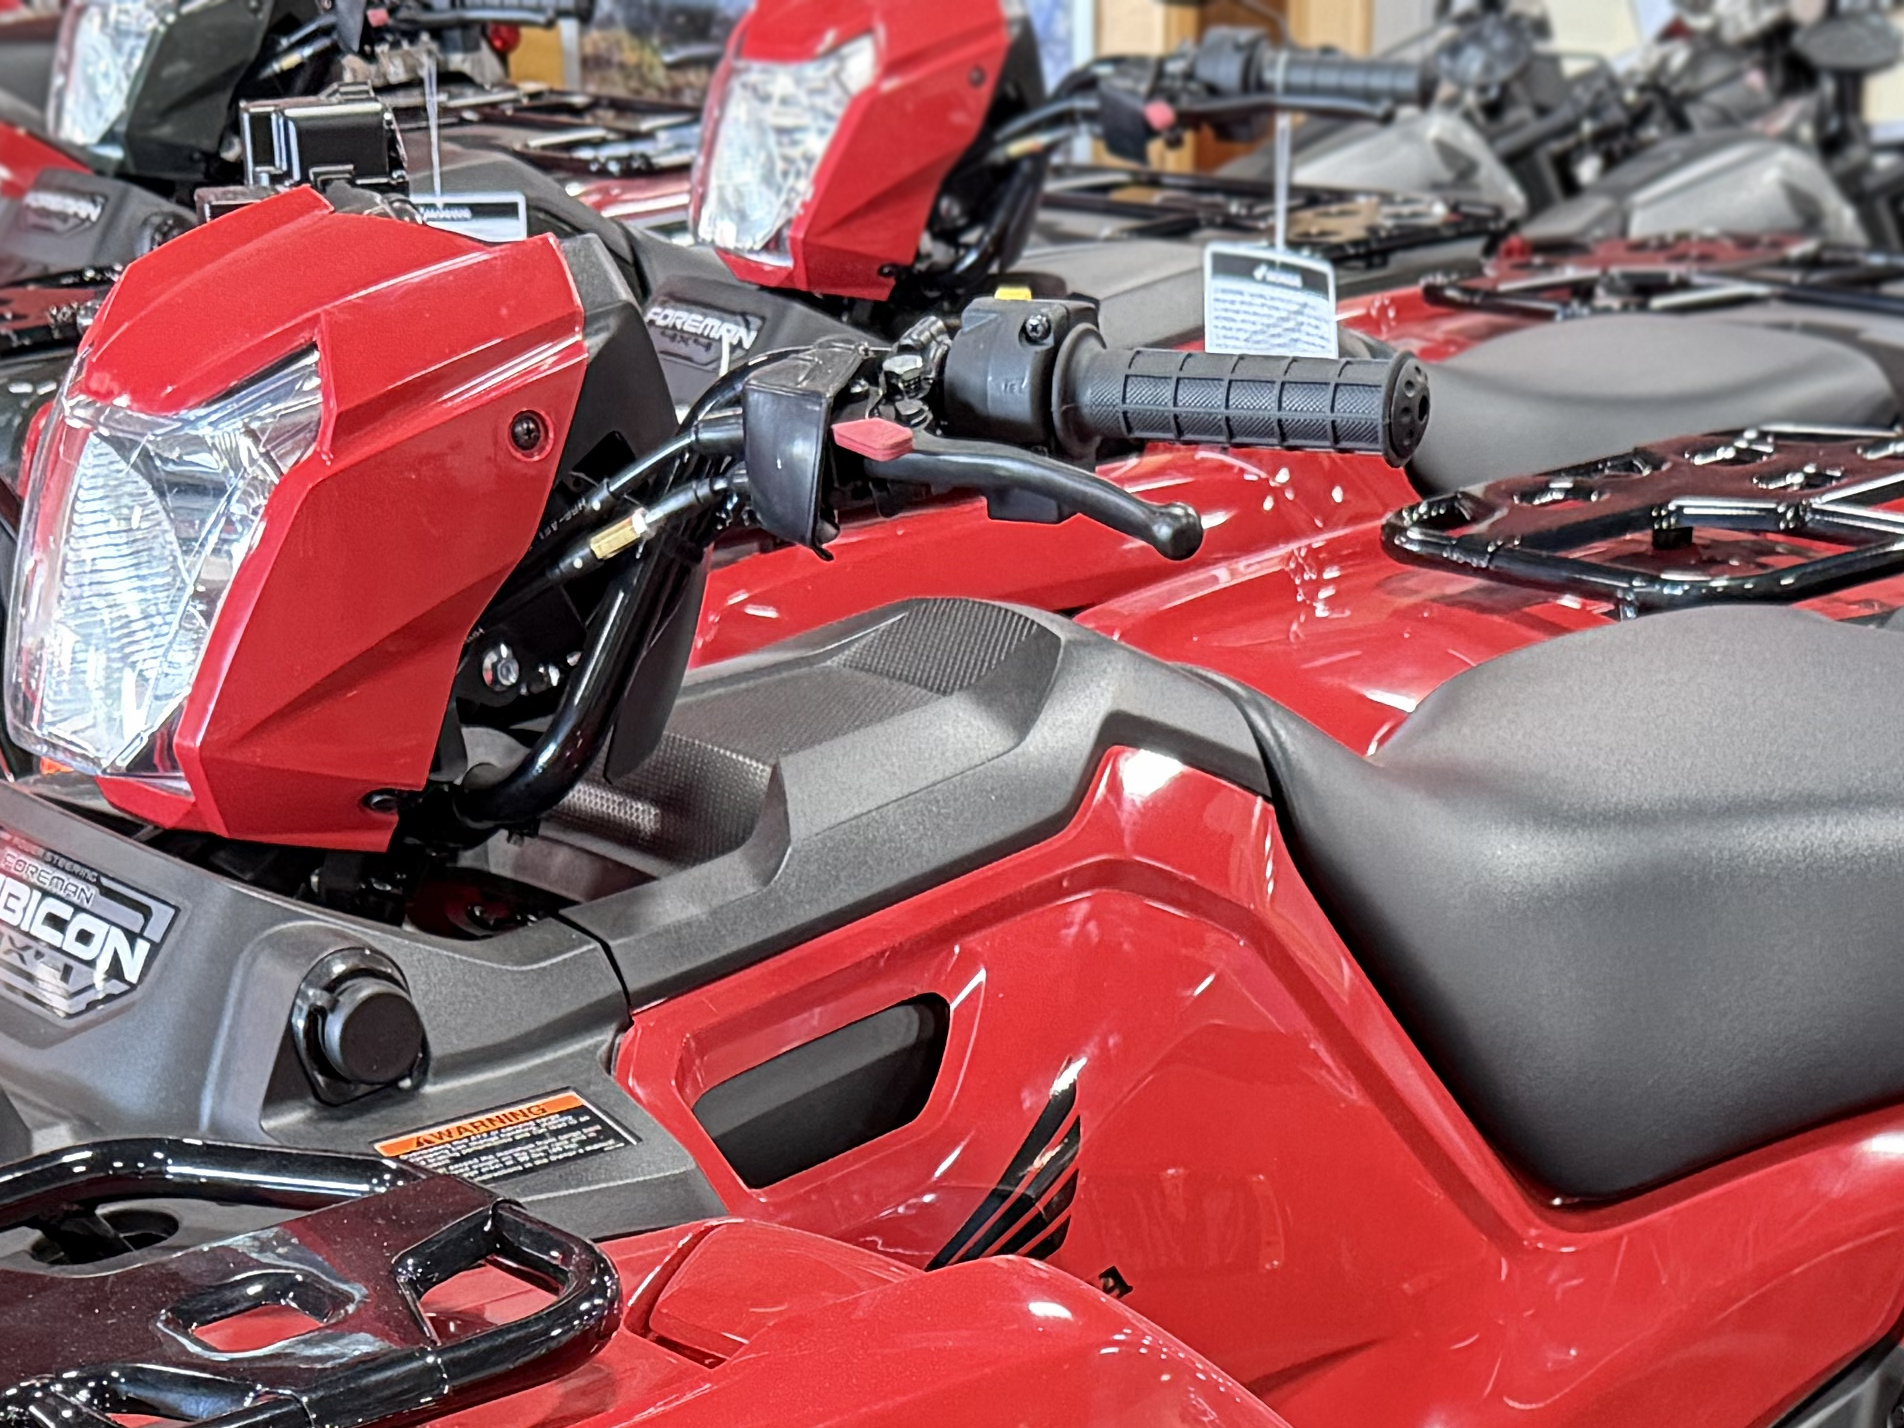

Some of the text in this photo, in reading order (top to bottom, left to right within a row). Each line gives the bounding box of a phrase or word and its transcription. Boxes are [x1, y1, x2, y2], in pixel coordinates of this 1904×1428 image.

[644, 306, 757, 350] FOREMAN
[1, 851, 95, 908] FOREMAN
[429, 1105, 549, 1143] WARNING
